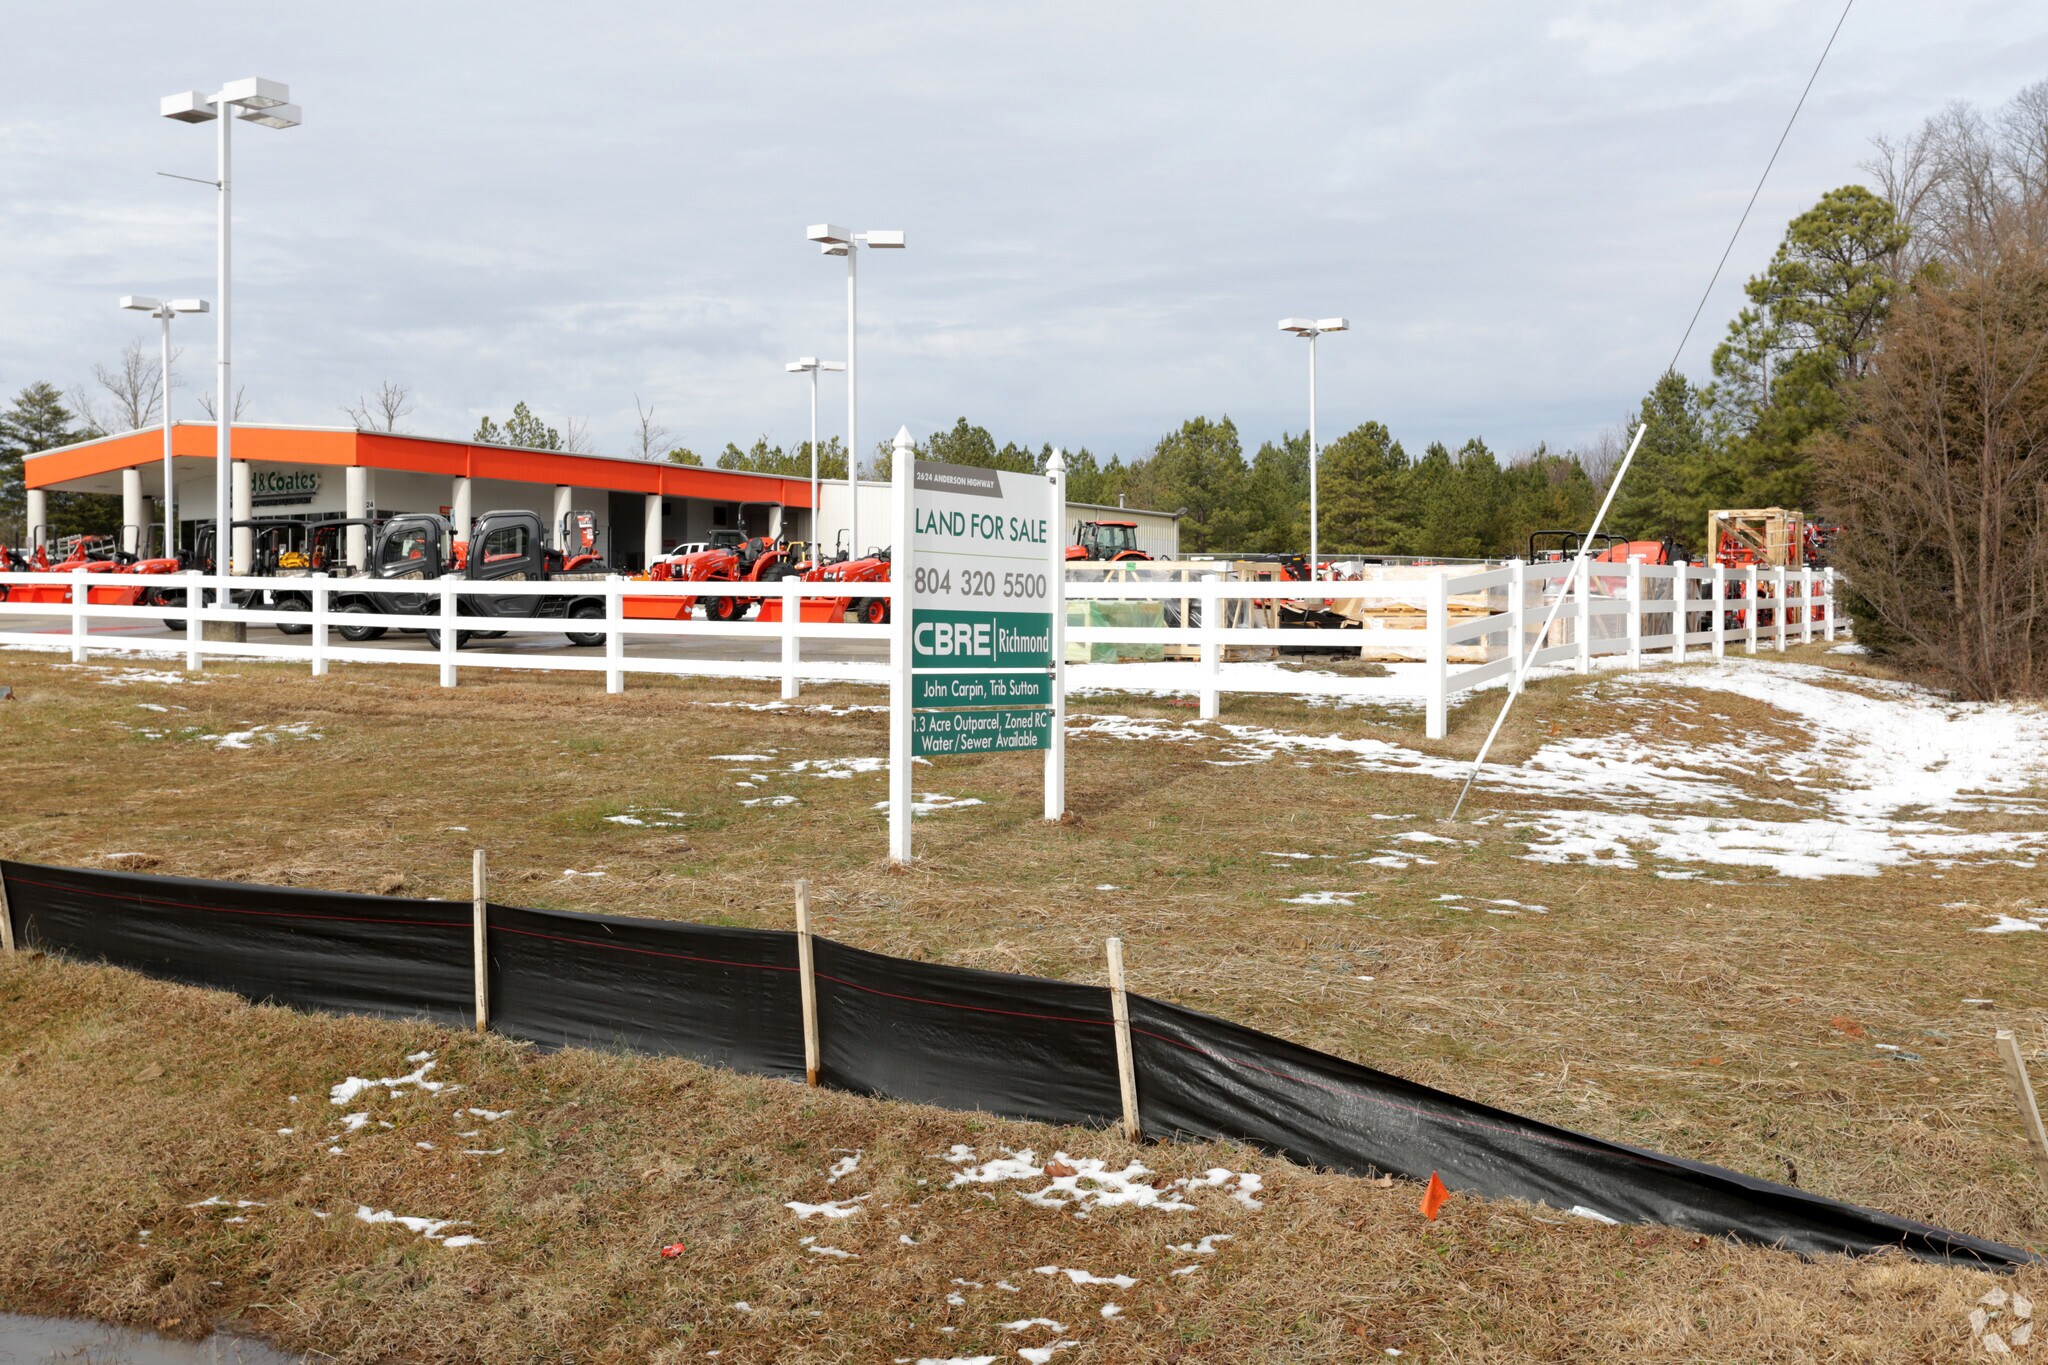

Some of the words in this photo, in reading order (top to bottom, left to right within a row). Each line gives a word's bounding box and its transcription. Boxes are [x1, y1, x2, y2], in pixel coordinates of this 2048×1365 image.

[268, 471, 316, 491] Coates
[916, 472, 933, 481] 2624
[934, 474, 966, 486] ANDERSON
[967, 477, 995, 488] HIGHWAY
[915, 508, 966, 537] LAND
[971, 513, 1004, 540] FOR
[1009, 517, 1047, 543] SALE
[914, 567, 951, 594] 804
[961, 570, 995, 597] 320
[1003, 572, 1047, 598] 5500
[914, 622, 991, 656] CBRE
[999, 627, 1049, 653] Richmond
[923, 680, 947, 697] John
[951, 680, 987, 700] Carpin,
[990, 679, 1006, 696] Trib
[1009, 679, 1039, 695] Sutton
[912, 716, 926, 733] 1.3
[929, 716, 951, 732] Acre
[954, 713, 1002, 734] Outparcel,
[1005, 711, 1033, 729] Zoned
[1035, 712, 1047, 728] RC
[996, 731, 1038, 748] Available
